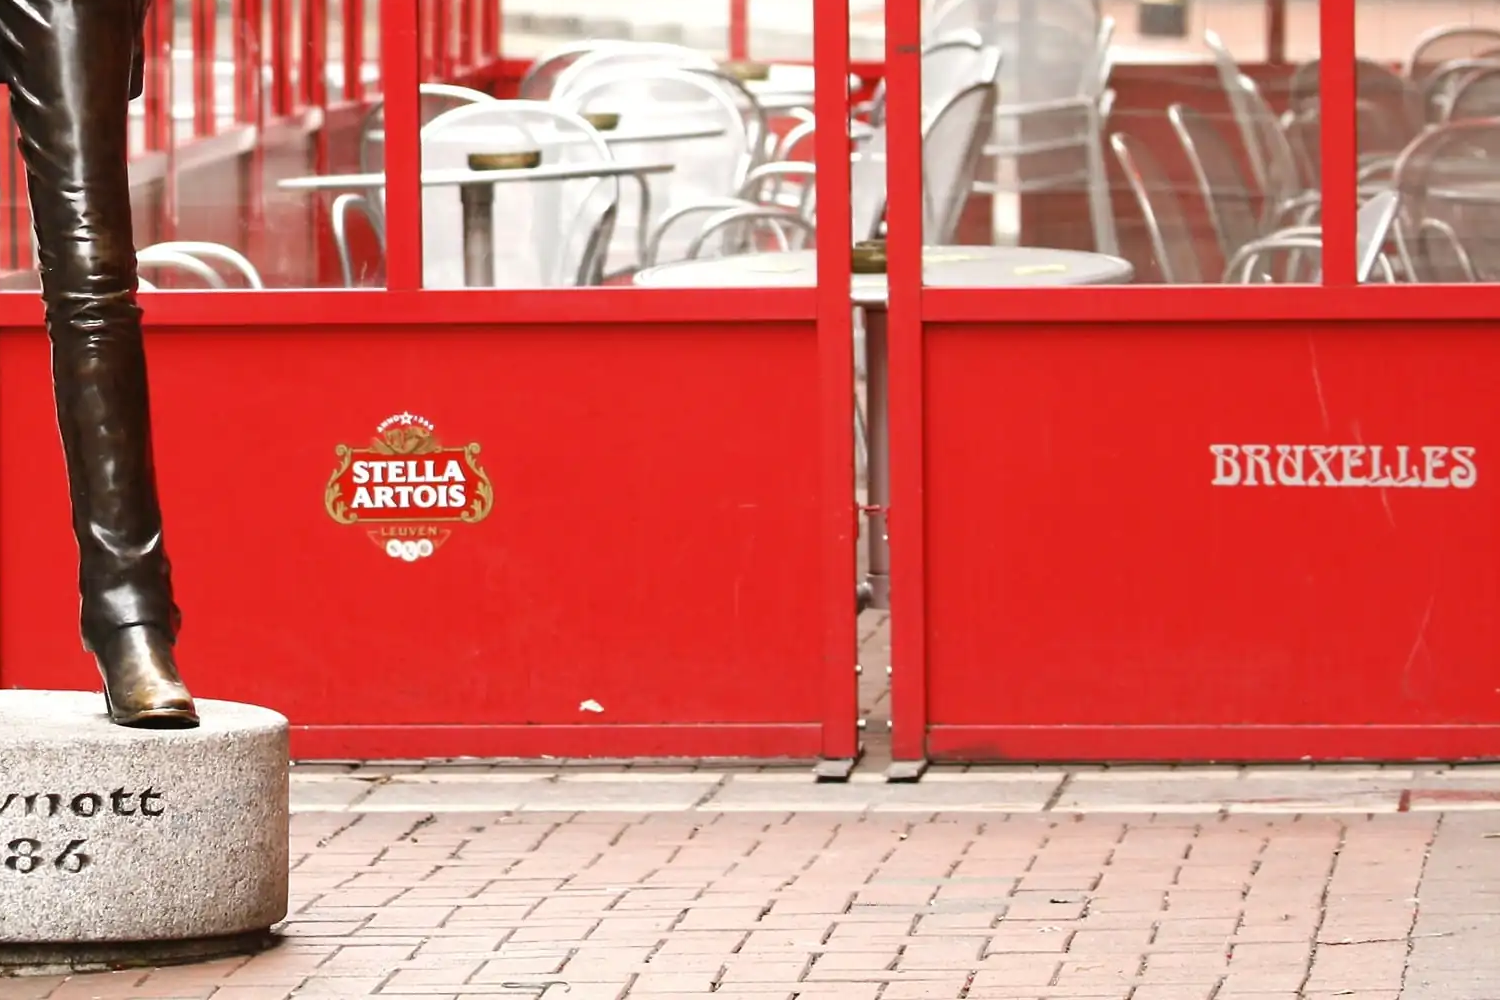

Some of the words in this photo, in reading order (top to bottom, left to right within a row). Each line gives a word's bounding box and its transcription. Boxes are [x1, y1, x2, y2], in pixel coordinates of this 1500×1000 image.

[352, 460, 466, 484] STELLA
[1209, 444, 1478, 488] BRUXELLES
[351, 485, 467, 509] ARTOIS
[381, 526, 439, 537] LEUVEN
